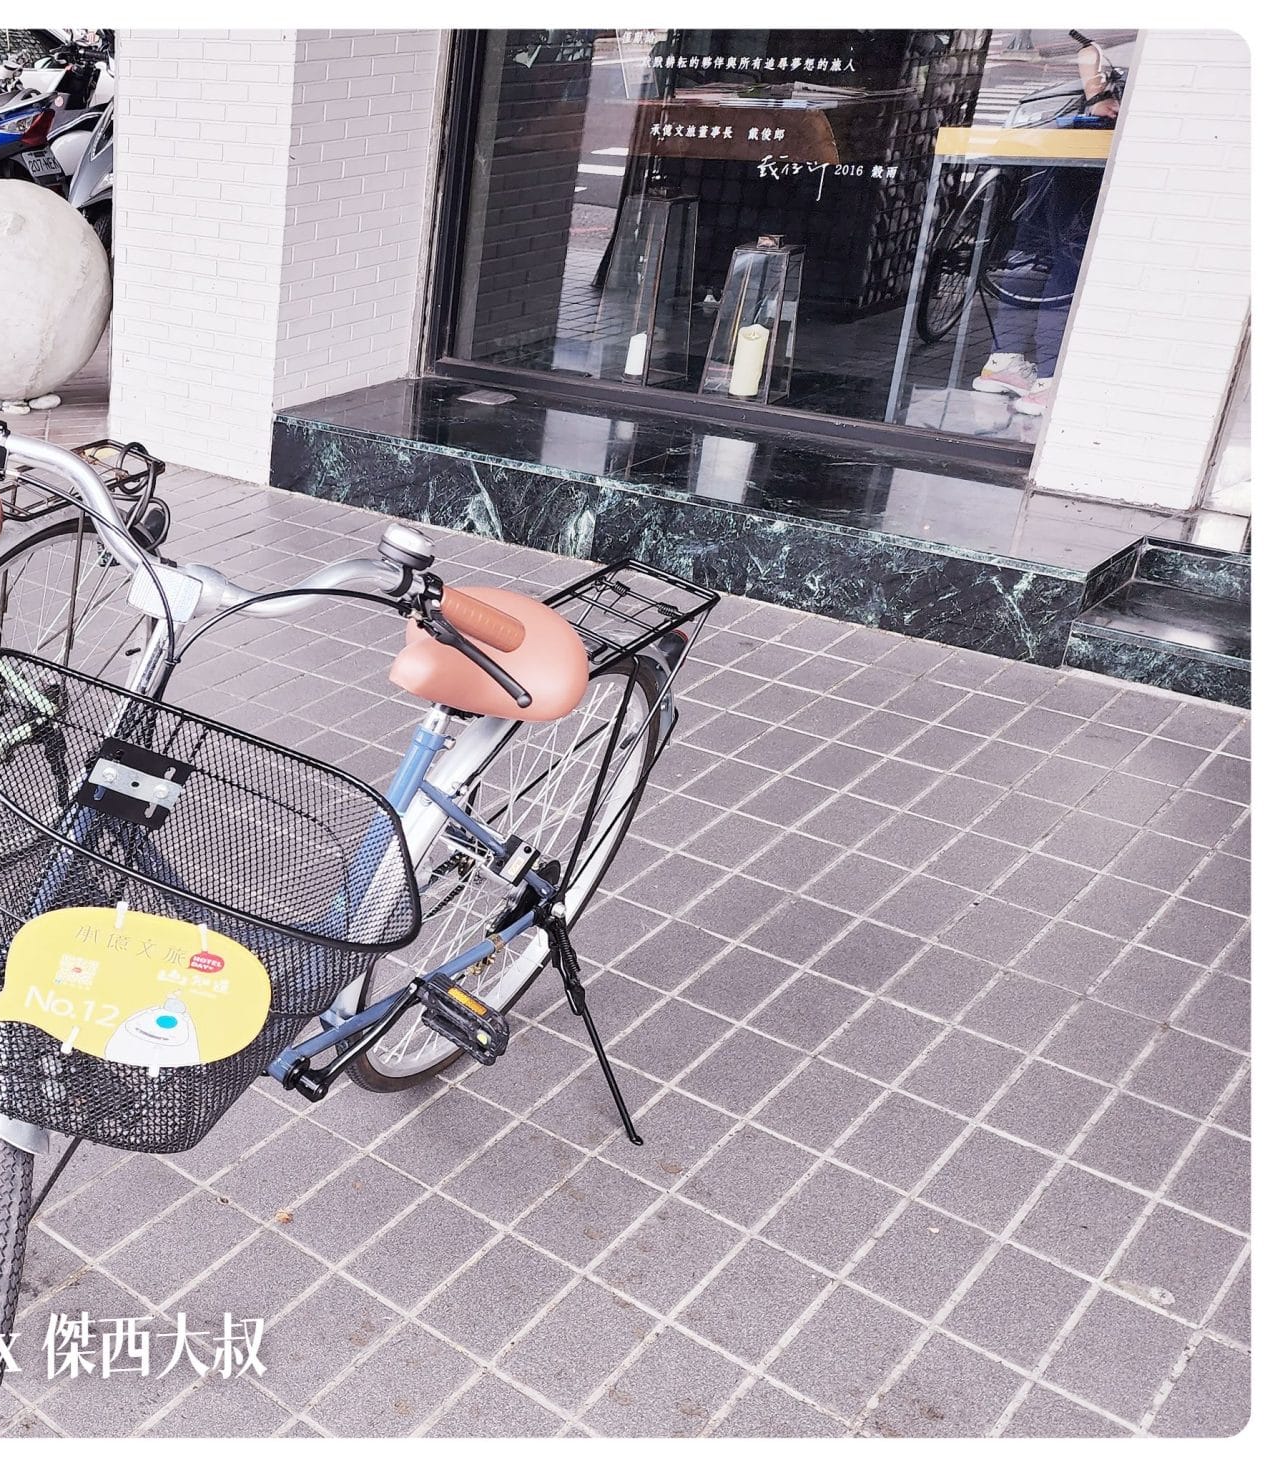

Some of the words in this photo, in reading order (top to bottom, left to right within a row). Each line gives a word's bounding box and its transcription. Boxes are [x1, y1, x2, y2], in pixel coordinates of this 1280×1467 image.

[834, 163, 864, 177] 2016
[192, 955, 222, 968] HOTEL
[24, 984, 120, 1028] No.12
